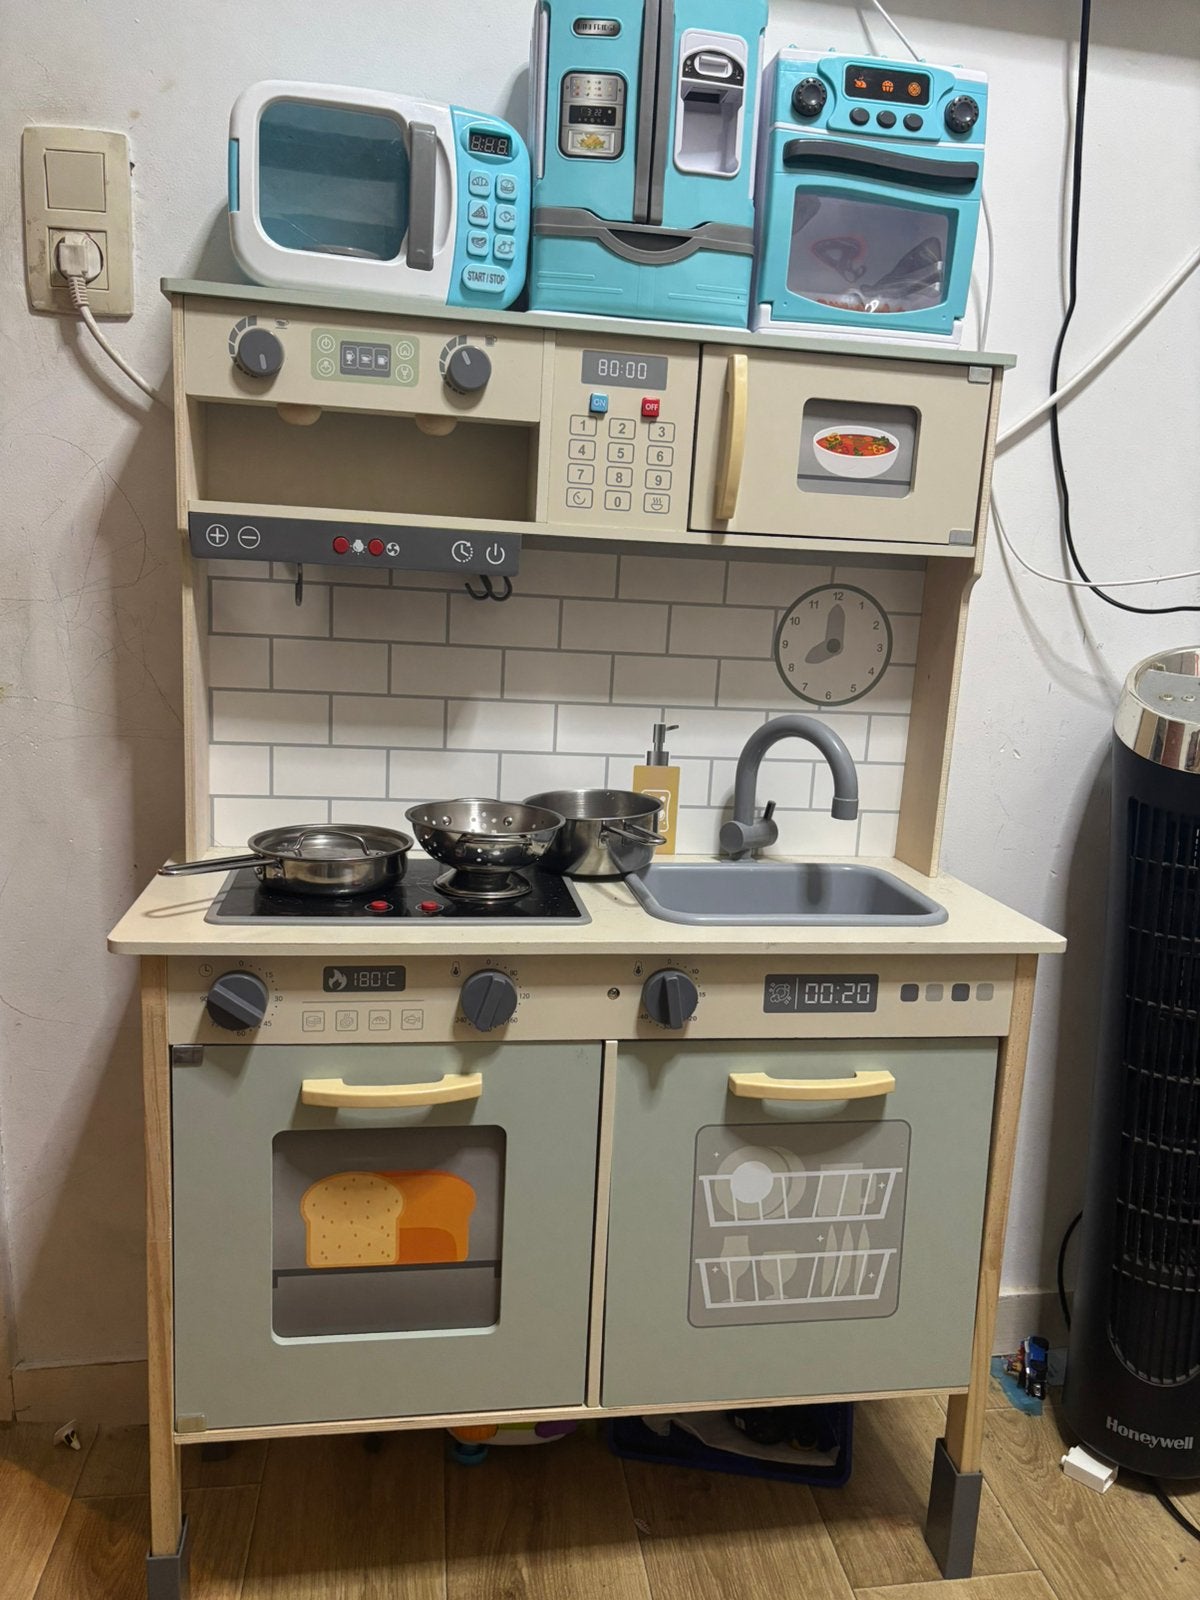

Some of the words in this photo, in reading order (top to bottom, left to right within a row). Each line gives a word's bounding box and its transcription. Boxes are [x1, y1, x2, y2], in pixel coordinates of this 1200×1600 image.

[598, 358, 648, 380] 80:00
[593, 398, 607, 408] ON
[645, 402, 659, 412] OFF
[580, 419, 587, 432] 1
[618, 422, 627, 435] 2
[658, 426, 666, 438] 3
[577, 444, 586, 456] 4
[616, 447, 625, 459] 5
[656, 450, 664, 462] 6
[576, 469, 585, 480] 7
[615, 471, 623, 484] 8
[654, 474, 663, 486] 9
[614, 495, 622, 508] 0
[832, 591, 844, 601] 12
[808, 600, 819, 609] 11
[859, 601, 865, 610] 1
[789, 616, 801, 626] 10
[872, 620, 880, 631] 2
[781, 639, 789, 649] 9
[876, 643, 883, 653] 3
[787, 663, 795, 673] 8
[867, 667, 875, 676] 4
[802, 682, 809, 692] 7
[850, 683, 857, 693] 5
[825, 690, 832, 700] 6
[265, 971, 274, 979] 15
[519, 992, 531, 1000] 120
[804, 982, 871, 1005] 00:20
[274, 995, 284, 1003] 30
[263, 1020, 272, 1028] 45
[1105, 1415, 1194, 1450] Honeywell
